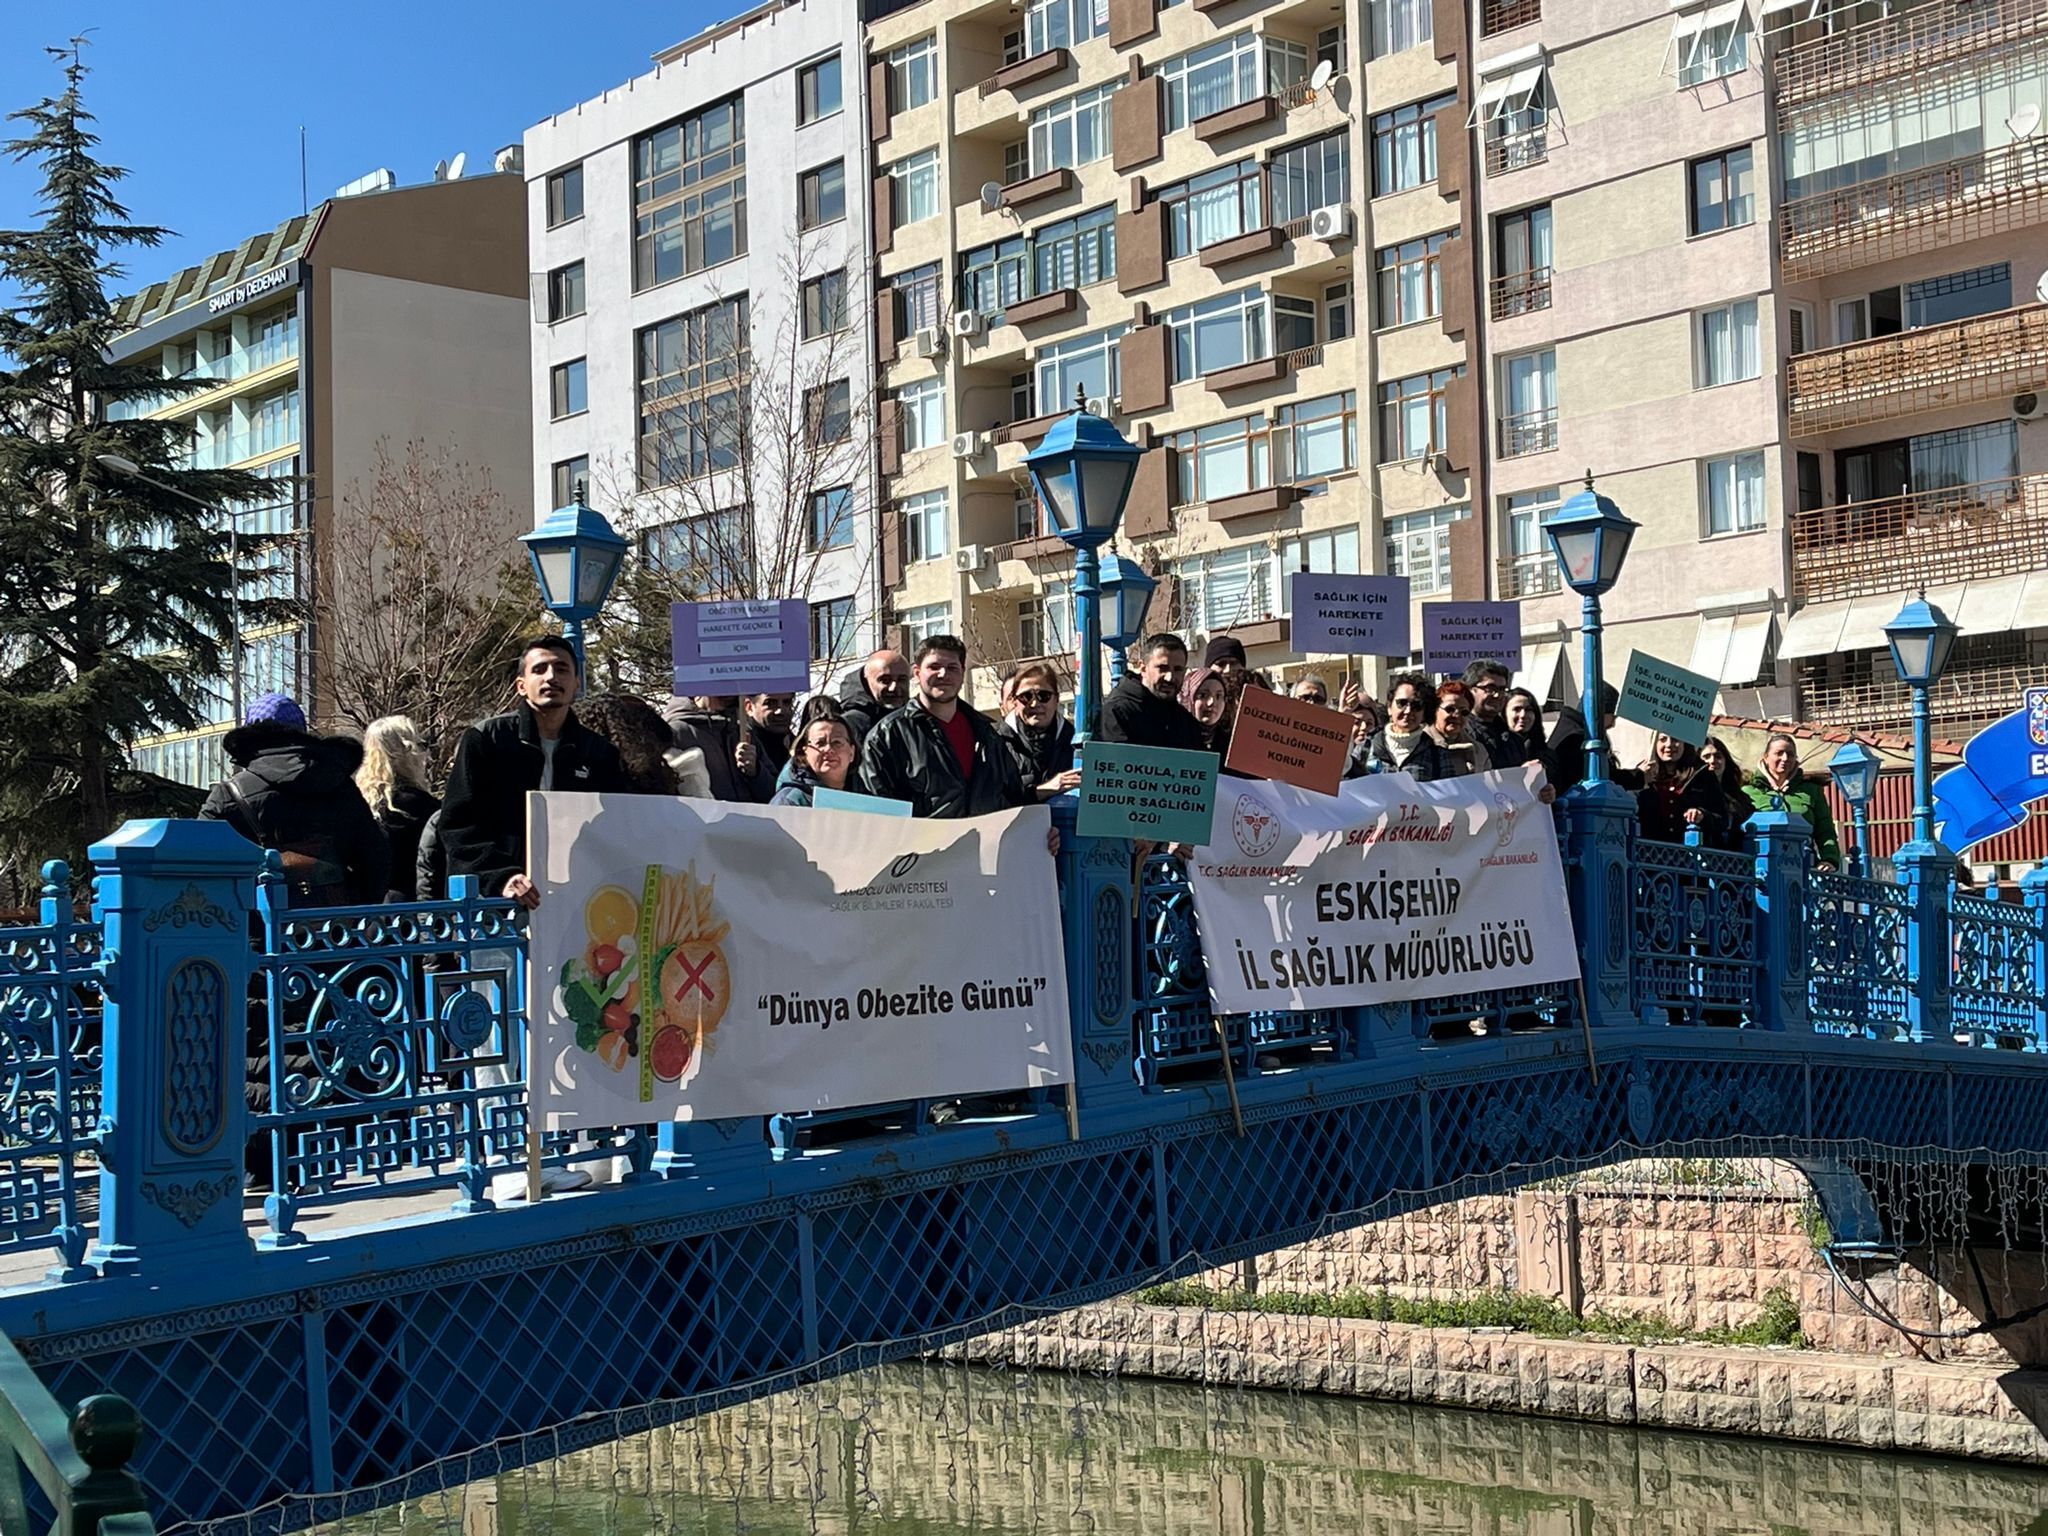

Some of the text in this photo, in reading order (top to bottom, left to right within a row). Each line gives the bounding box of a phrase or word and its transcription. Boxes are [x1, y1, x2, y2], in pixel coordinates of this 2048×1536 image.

[209, 267, 287, 313] SMART by DEDEMAN
[1313, 591, 1387, 604] SAĞLIK İÇİN
[1318, 609, 1383, 620] HAREKETE
[1441, 616, 1502, 626] SAĞLIK İÇİN
[703, 622, 773, 633] HAREKETE GEÇMEK
[1328, 626, 1366, 637] GEÇİN
[1440, 632, 1504, 641] HAREKET ET
[1506, 650, 1517, 658] ET
[745, 665, 771, 673] NEDEN
[1634, 677, 1704, 709] HER GÜN YÜRÜ
[1654, 672, 1688, 692] OKULA,
[1691, 686, 1710, 699] EVE
[1627, 687, 1705, 722] BUDUR SAĞLIĞIN
[1243, 706, 1346, 743] DÜZENLİ EGZERSİZ
[1257, 729, 1323, 755] SAĞLIĞINIZI
[1267, 750, 1306, 768] KORUR
[1094, 759, 1207, 780] İŞE, OKULA, EVE
[1096, 778, 1201, 795] HER GÜN YÜRÜ
[1088, 793, 1206, 813] BUDUR SAĞLIĞIN
[1128, 810, 1161, 824] ÖZÜ!
[1346, 822, 1455, 846] SAĞLIK BAKANLIĞI
[1198, 865, 1214, 877] T.C.
[1216, 864, 1248, 877] SAĞLIK
[885, 880, 948, 895] ÜNİVERSİTESİ
[1315, 868, 1462, 925] ESKİŞEHİR
[1235, 919, 1535, 990] İL SAĞLIK MÜDÜRLÜĞÜ
[757, 977, 1047, 1029] “Dünya Obezite Günü”
